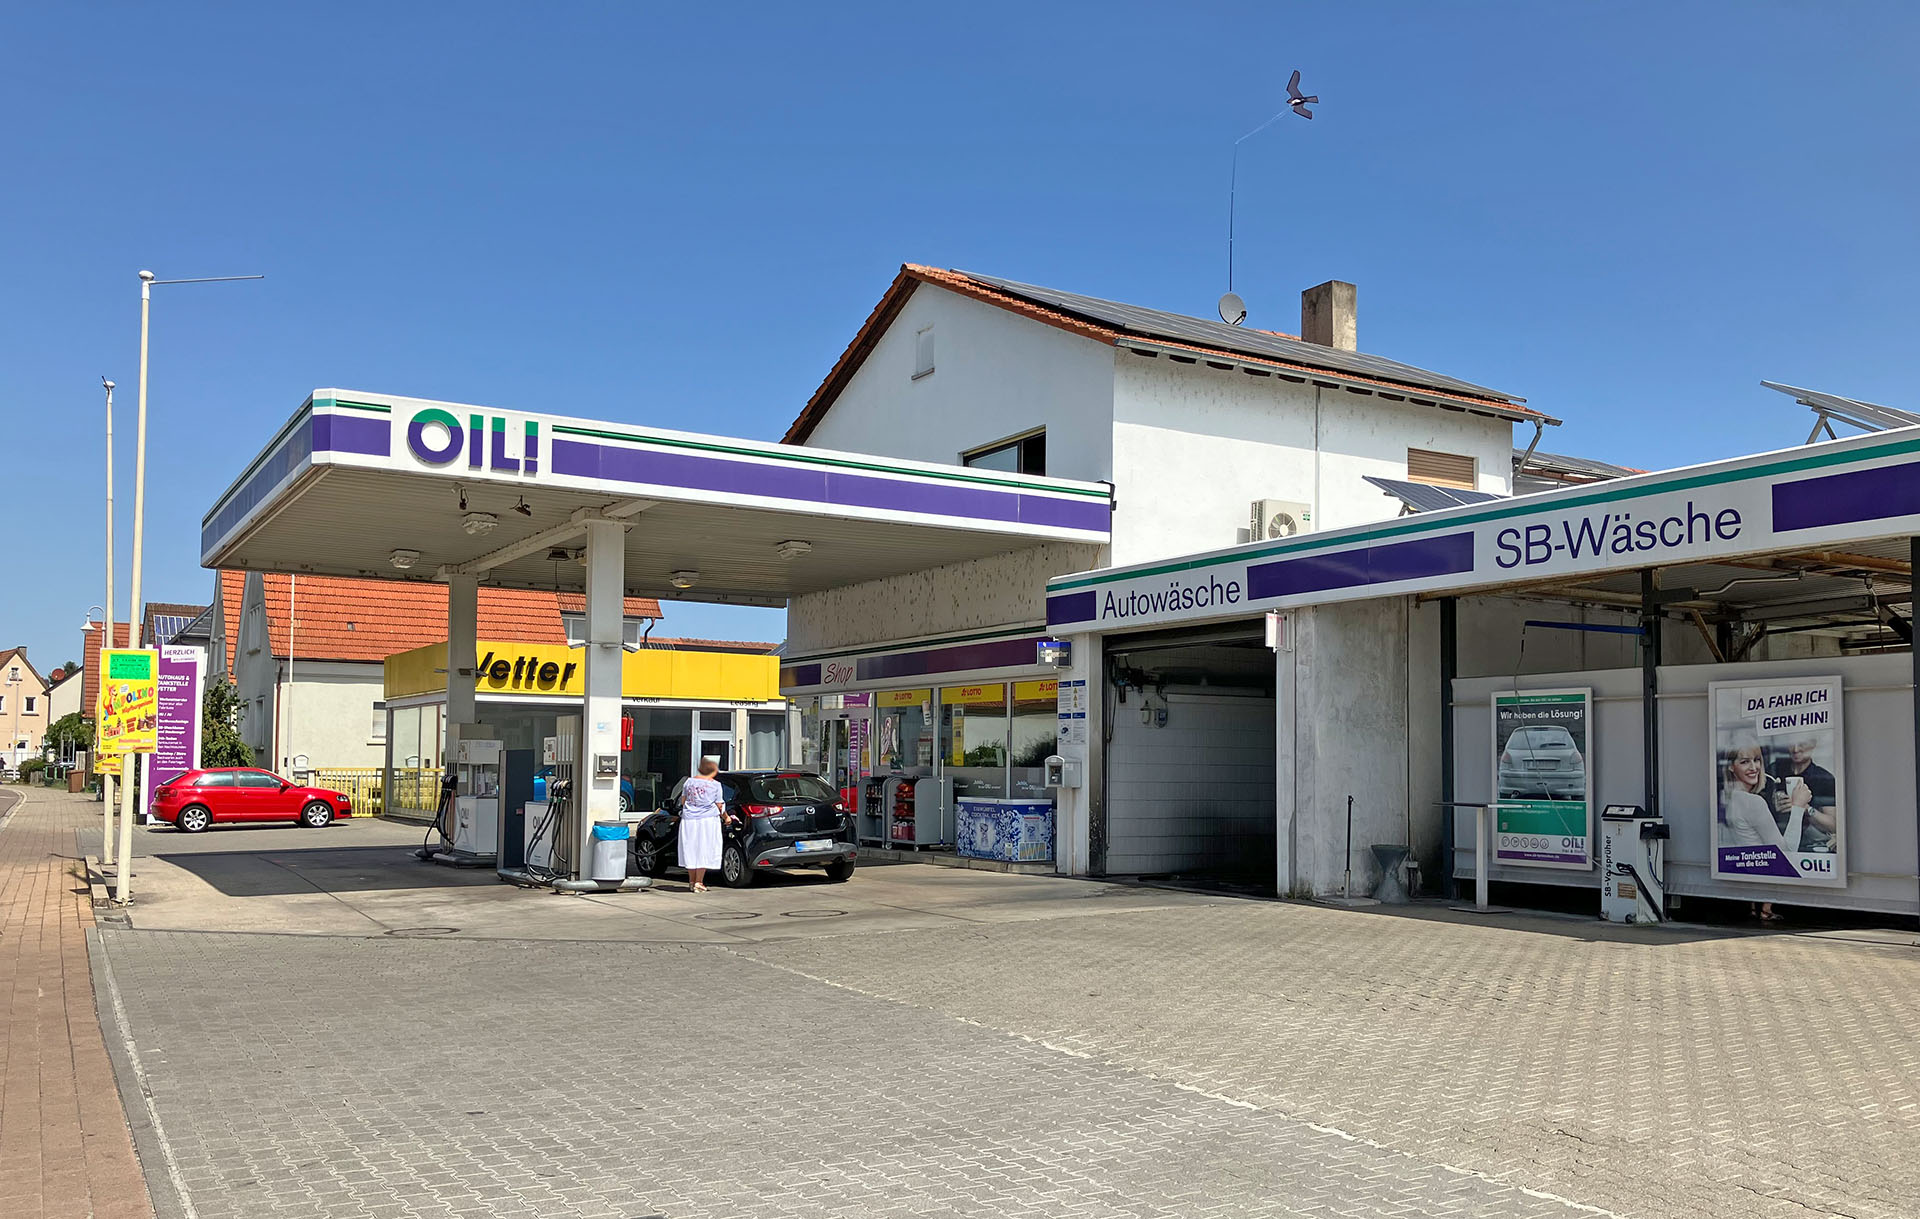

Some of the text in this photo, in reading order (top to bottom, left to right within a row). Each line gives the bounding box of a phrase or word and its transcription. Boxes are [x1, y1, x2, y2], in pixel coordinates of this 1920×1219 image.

[407, 408, 539, 474] OIL!
[1495, 501, 1742, 569] SB-Wäsche
[1102, 575, 1241, 620] Autowäsche
[824, 662, 853, 686] Shop
[967, 688, 982, 696] LOTTO
[1046, 682, 1058, 691] LOTT
[103, 686, 155, 720] JUMPOLINO
[1747, 689, 1827, 711] DA FAHR ICH
[1501, 709, 1583, 720] Wir haben die Lösung!
[1762, 711, 1828, 730] GERN HIN!
[1562, 836, 1584, 849] OIL!
[1740, 851, 1777, 861] Tankstelle
[1800, 858, 1831, 873] OIL!
